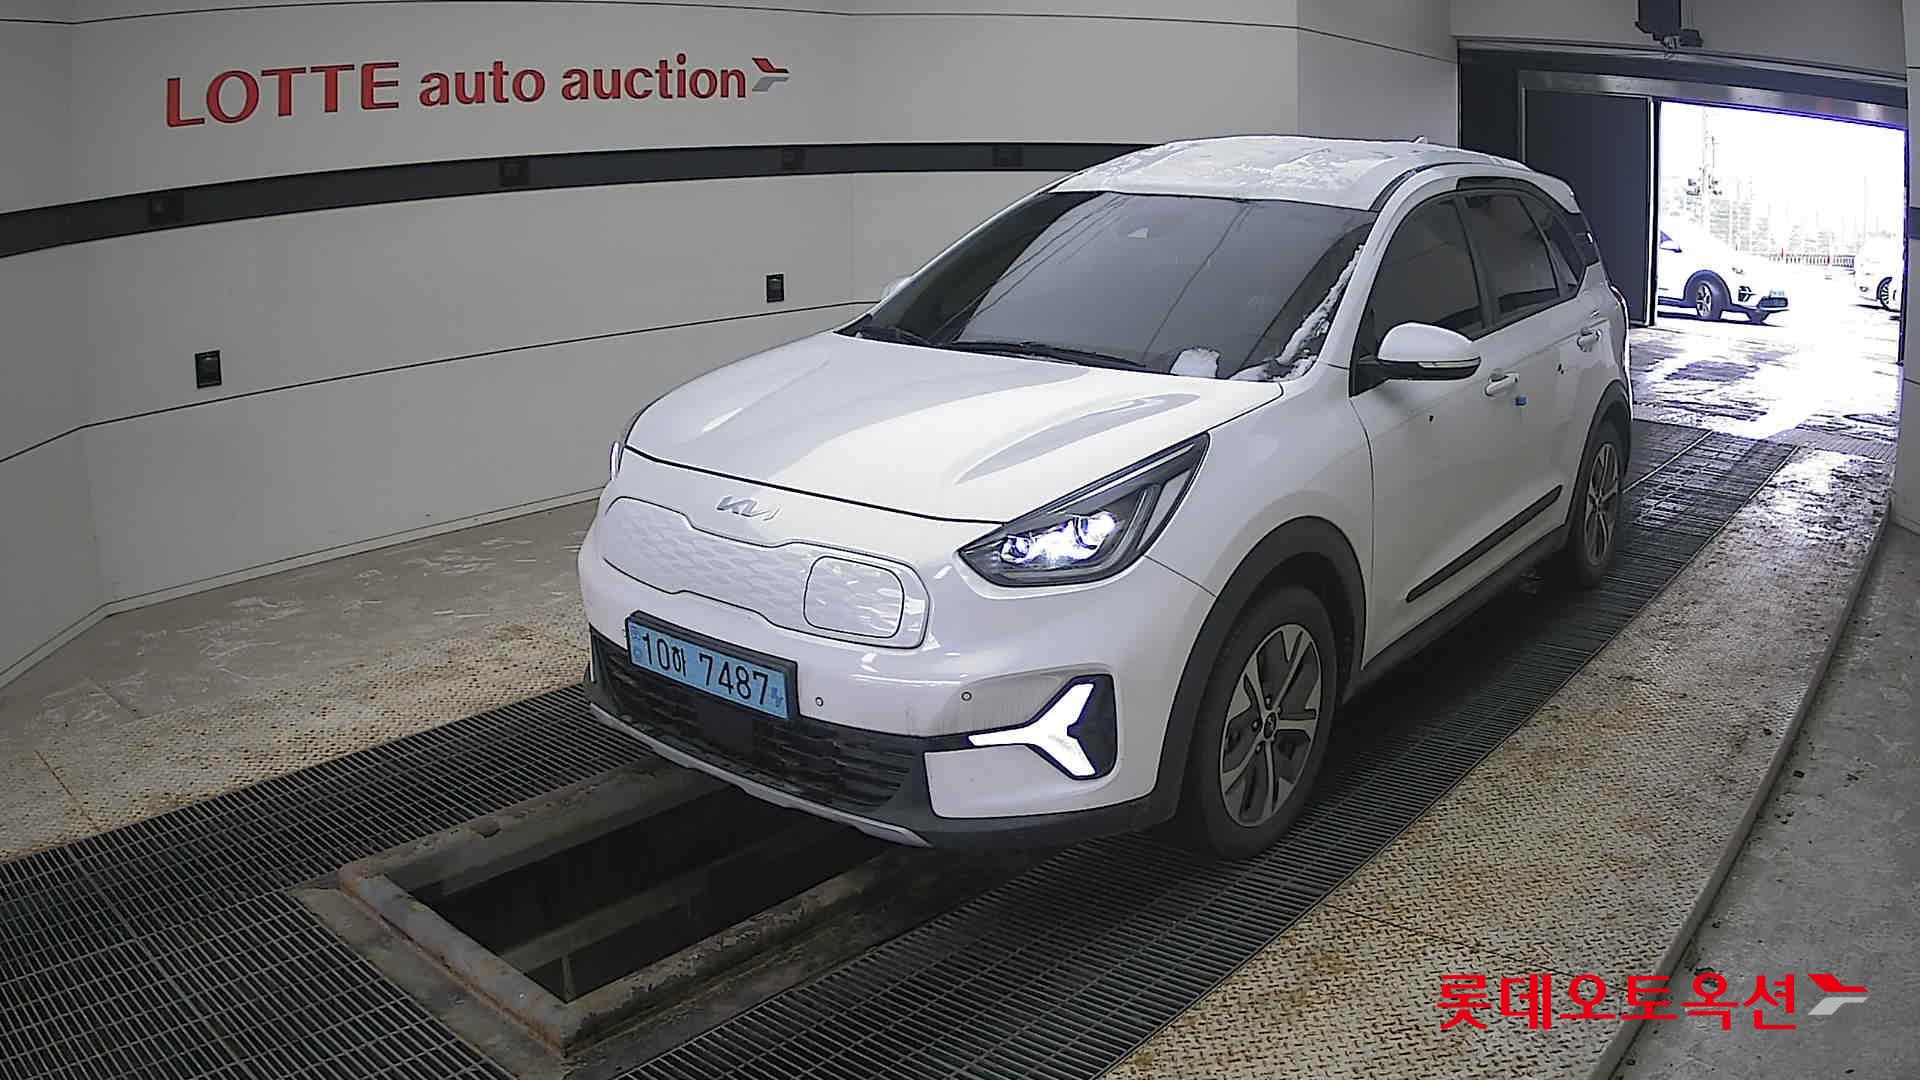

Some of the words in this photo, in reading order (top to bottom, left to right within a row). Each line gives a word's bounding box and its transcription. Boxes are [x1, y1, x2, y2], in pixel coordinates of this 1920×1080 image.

[165, 61, 399, 128] LOTTE
[418, 60, 545, 107] auto
[561, 53, 747, 100] auction
[642, 632, 687, 677] 10하
[698, 653, 769, 705] 7487
